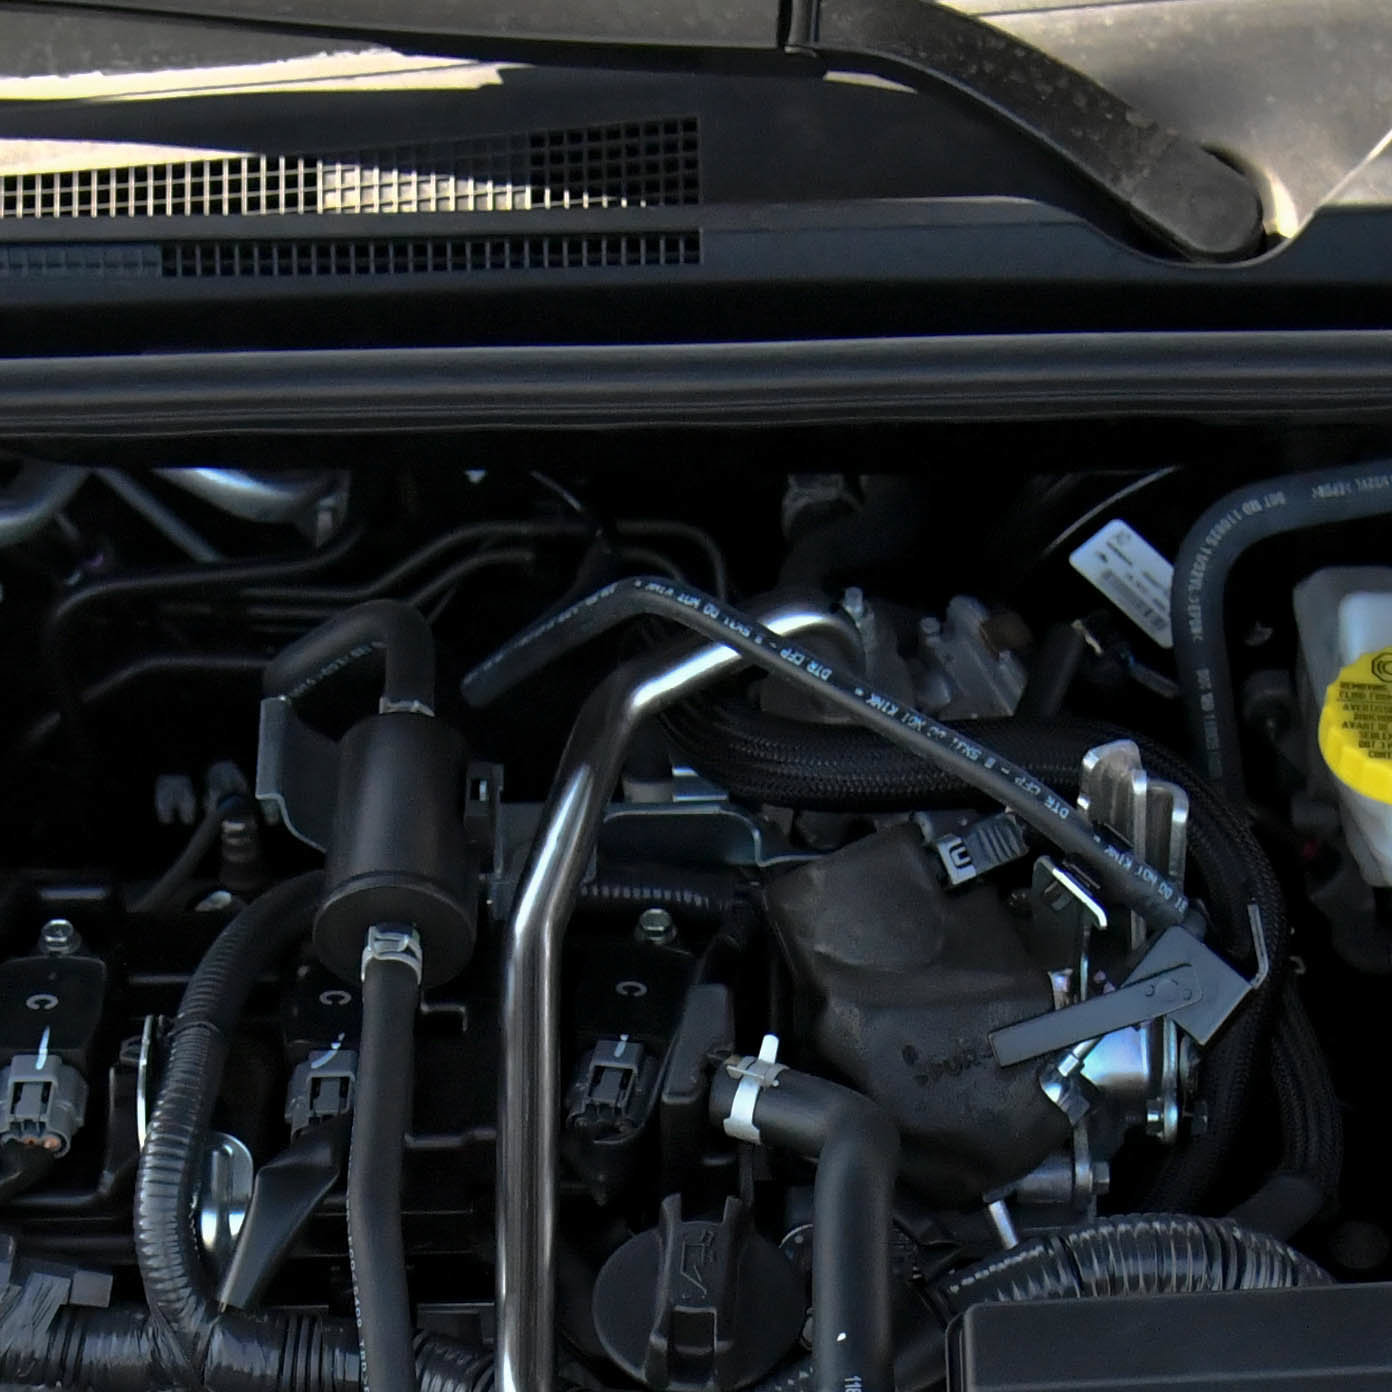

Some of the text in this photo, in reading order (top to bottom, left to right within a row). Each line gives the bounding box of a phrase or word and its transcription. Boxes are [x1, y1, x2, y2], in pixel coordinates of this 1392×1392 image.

[616, 981, 647, 997] C
[26, 994, 58, 1010] C
[319, 990, 351, 1006] C
